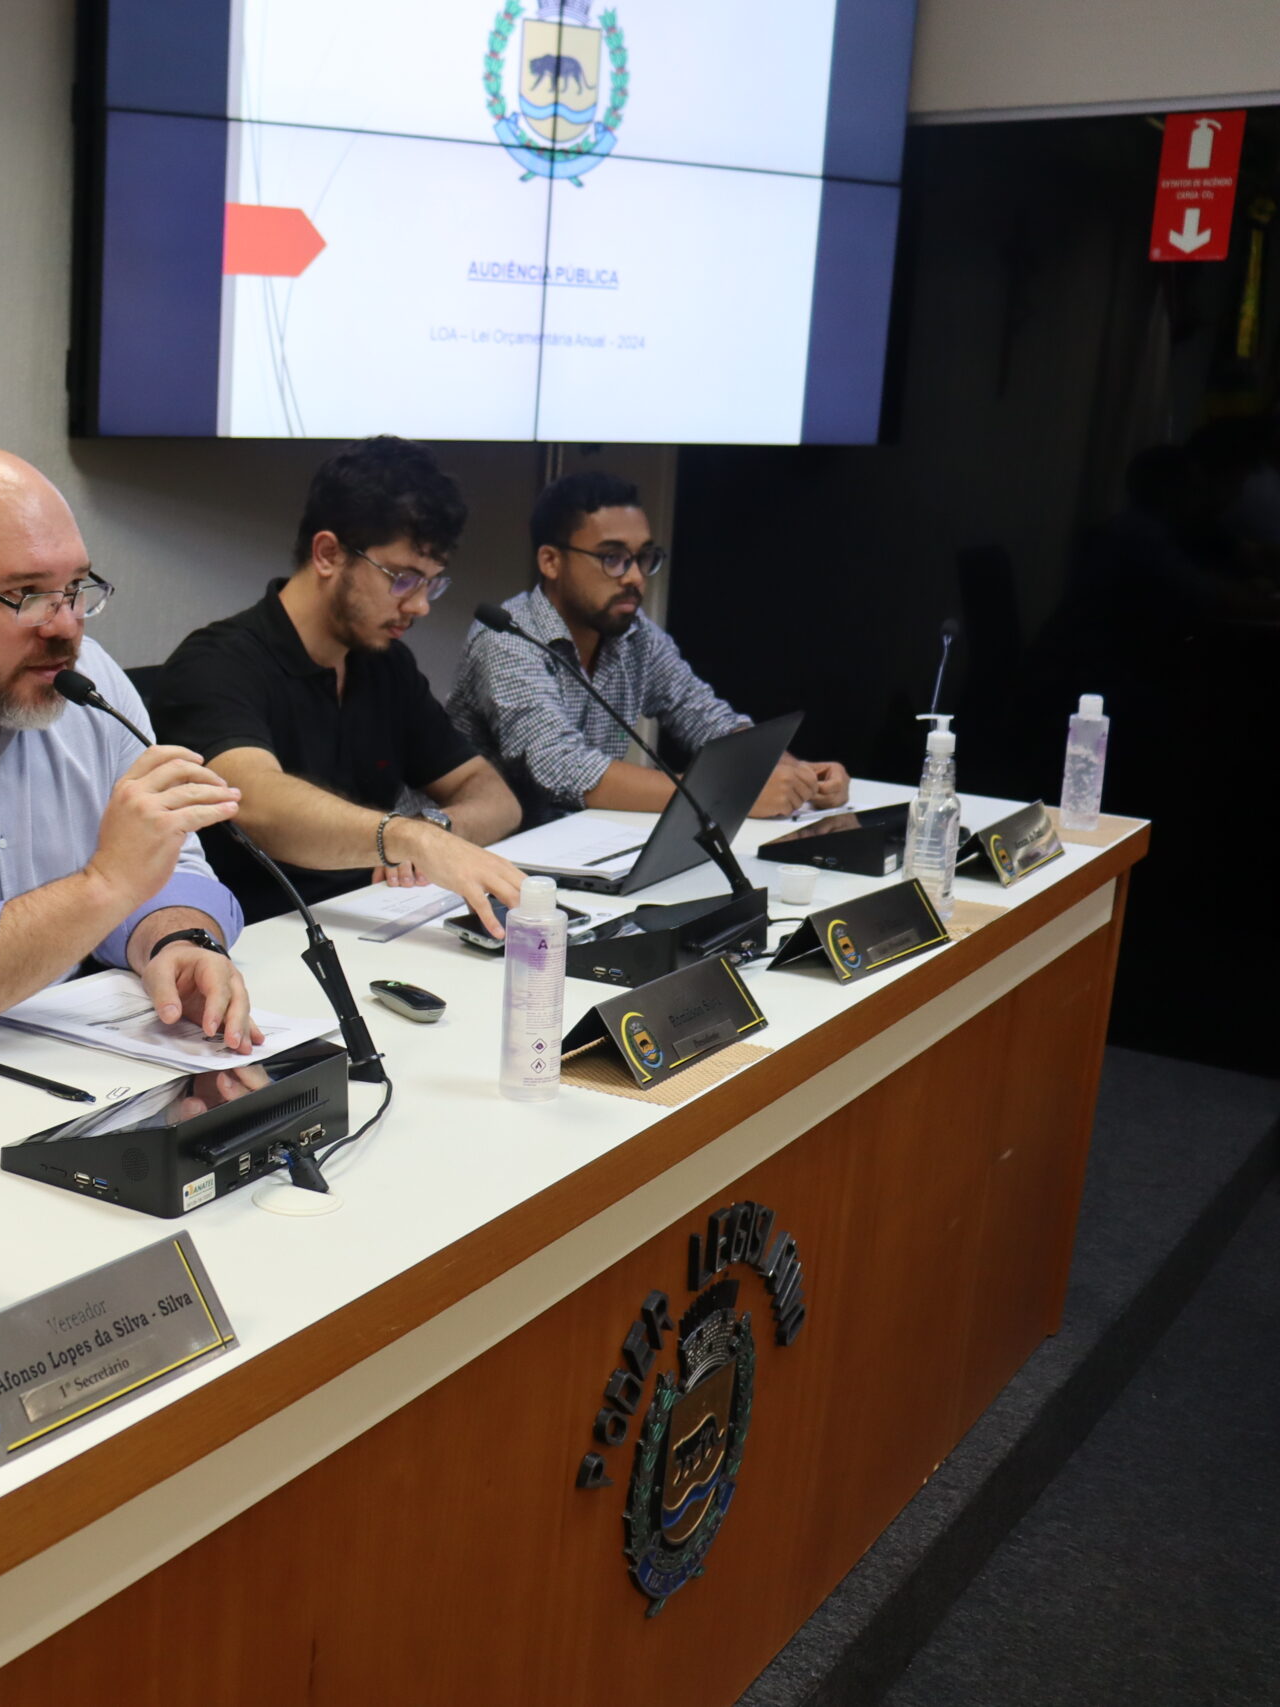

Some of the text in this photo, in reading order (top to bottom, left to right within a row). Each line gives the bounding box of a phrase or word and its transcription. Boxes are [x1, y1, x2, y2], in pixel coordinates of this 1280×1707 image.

[468, 260, 619, 285] AUDIÊNCIA PÚBLICA
[430, 326, 457, 341] LOA
[471, 328, 489, 343] Lei
[493, 328, 574, 347] Orçamentária
[575, 332, 606, 348] Anual
[617, 334, 646, 349] 2024
[46, 1300, 107, 1334] Vereador
[48, 1339, 92, 1369] Lopes
[95, 1328, 113, 1348] da
[112, 1315, 150, 1339] Silva
[157, 1292, 193, 1317] Silva
[74, 1357, 130, 1391] Secretário
[575, 1290, 674, 1489] PODER
